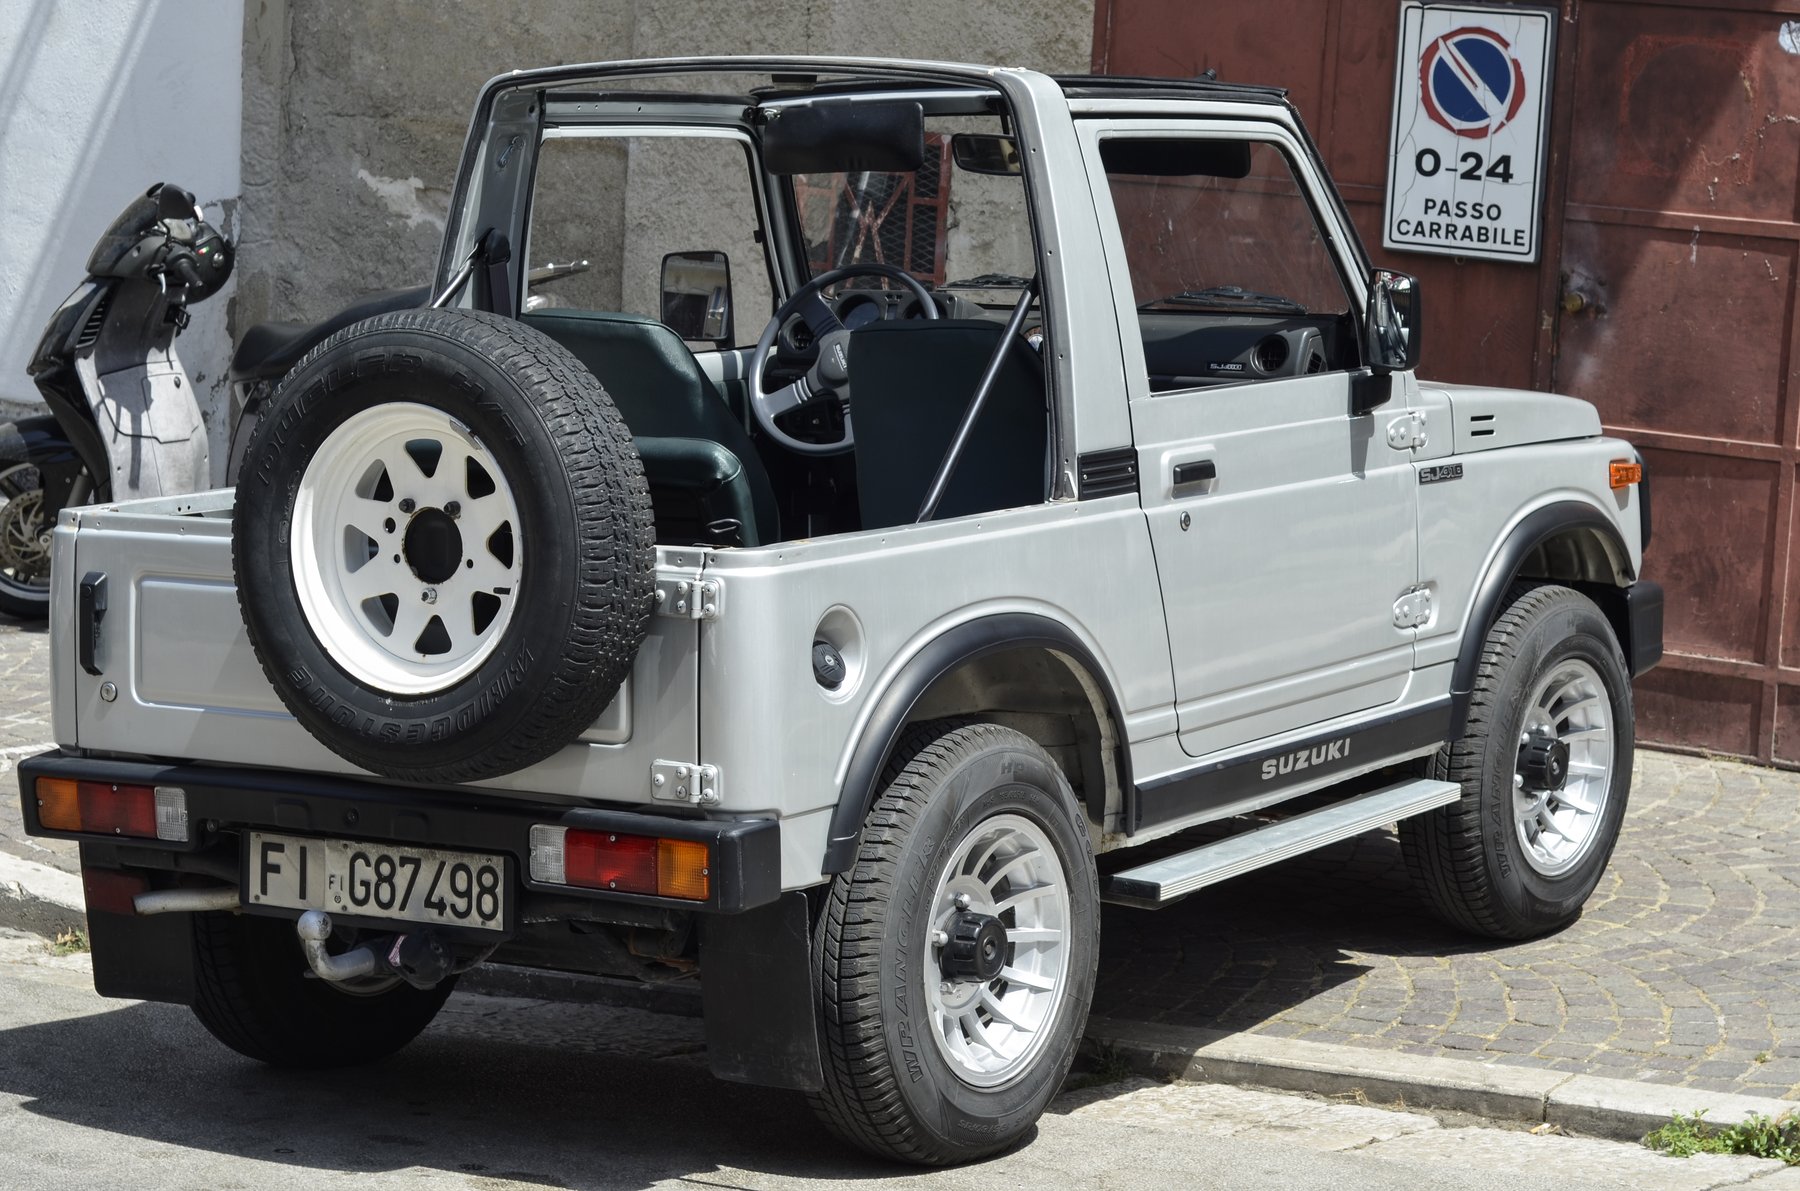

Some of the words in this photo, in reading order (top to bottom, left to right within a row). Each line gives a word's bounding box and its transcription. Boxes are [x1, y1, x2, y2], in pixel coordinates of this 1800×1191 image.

[1415, 147, 1514, 184] 0-24
[1423, 198, 1502, 222] PASSO
[1396, 219, 1526, 247] CARRABILE
[1420, 464, 1463, 482] SJ410
[1261, 737, 1351, 780] SUZUKI
[260, 841, 307, 901] FI
[328, 873, 343, 891] FI
[349, 851, 499, 922] G87498
[894, 831, 935, 1085] WRANGLER
